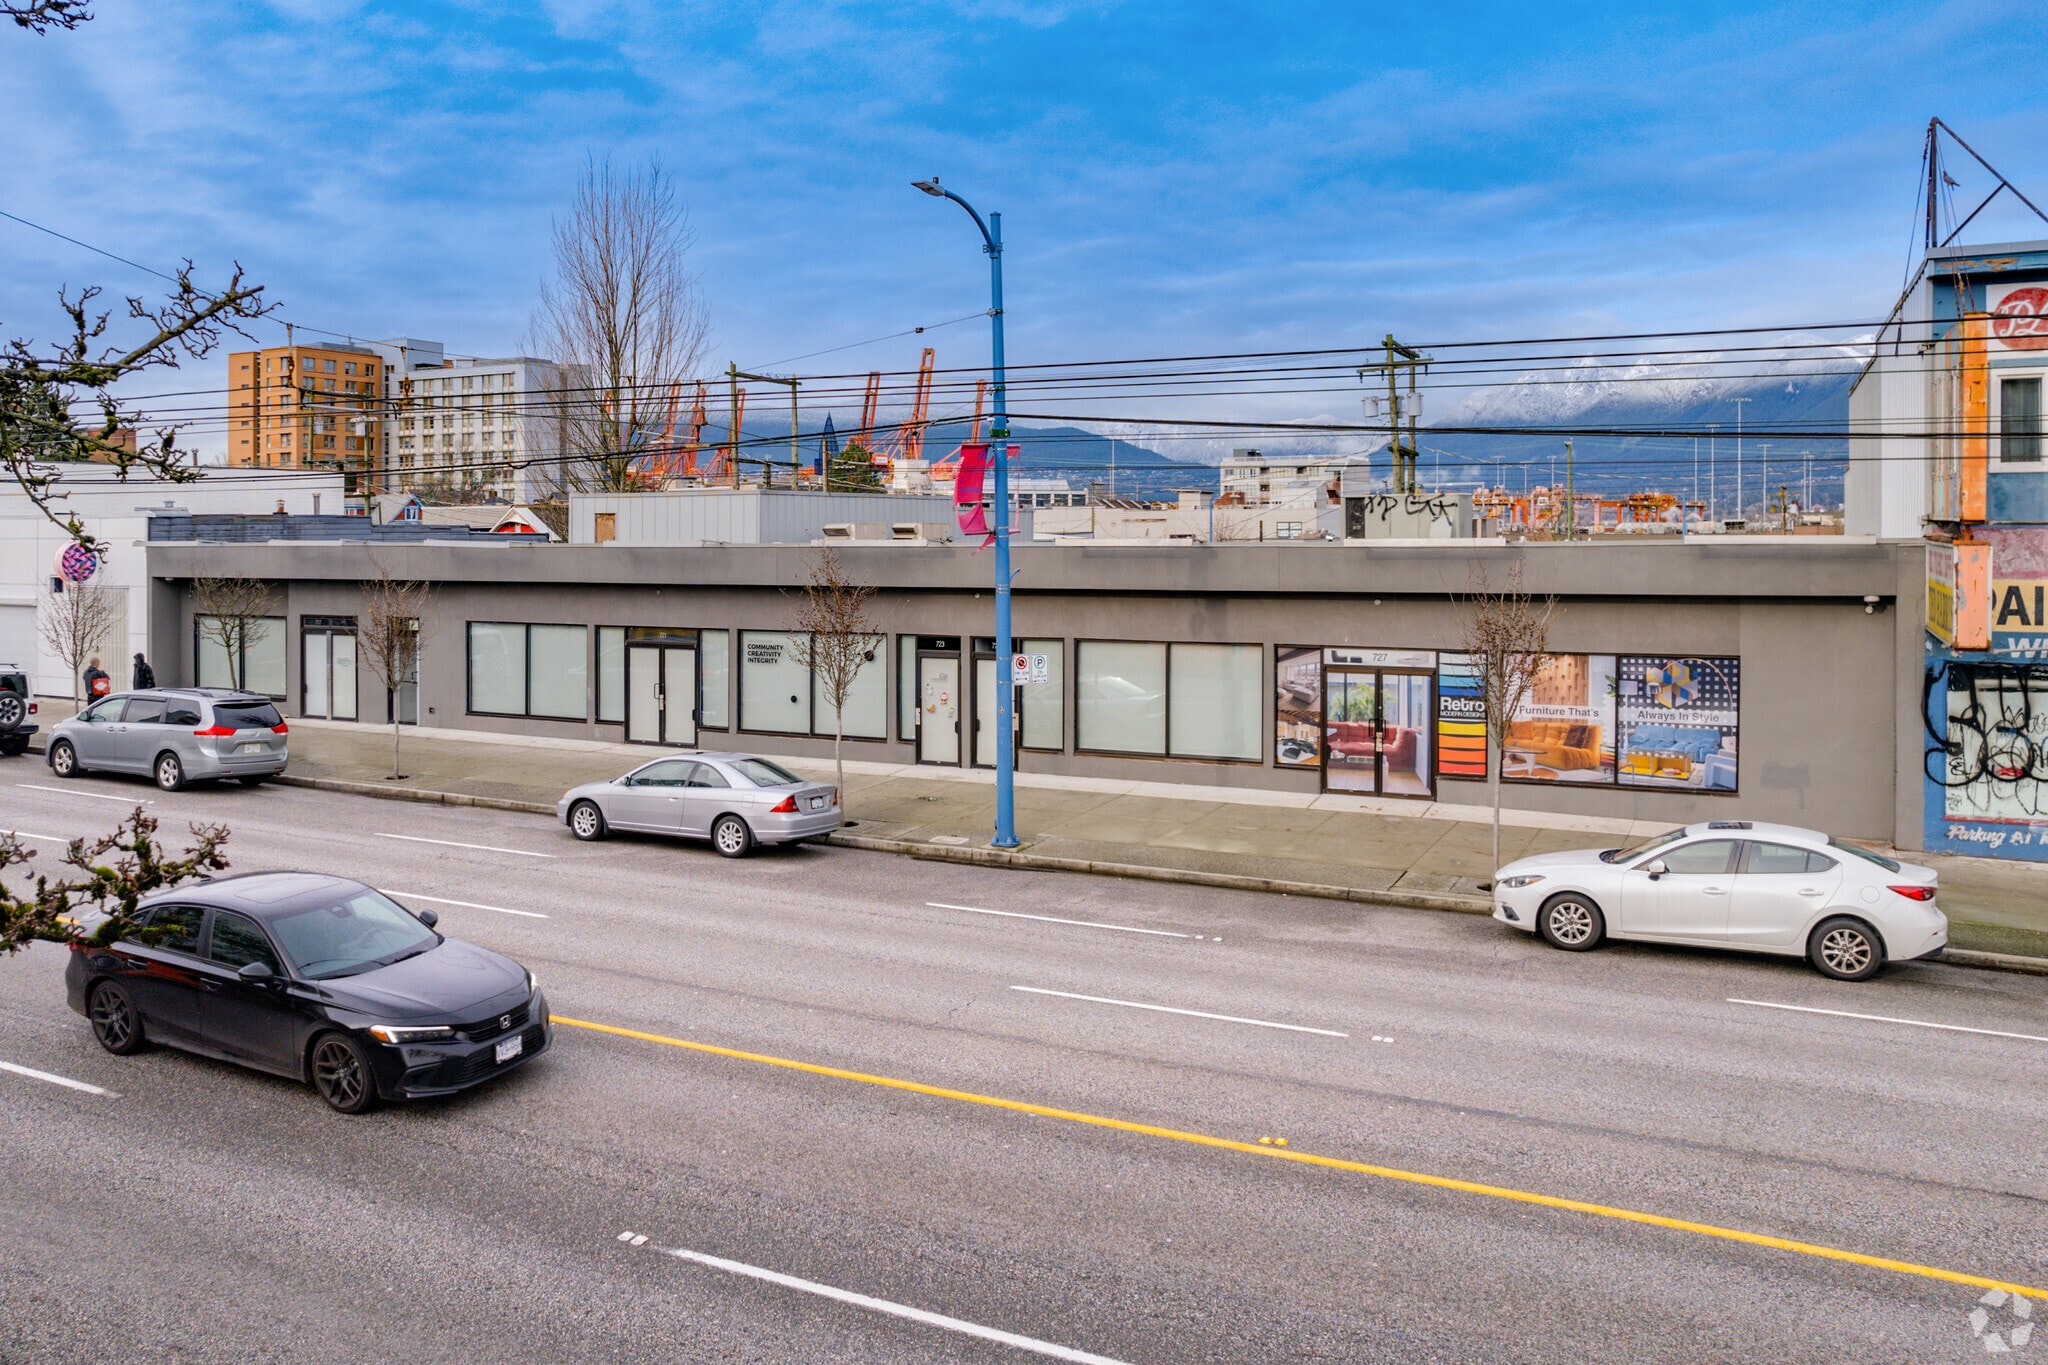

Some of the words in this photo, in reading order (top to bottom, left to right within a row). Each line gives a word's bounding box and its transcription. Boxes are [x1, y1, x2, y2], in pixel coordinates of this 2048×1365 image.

[1992, 586, 2045, 626] AI
[935, 640, 945, 648] 723
[1372, 653, 1388, 662] 727
[1440, 696, 1486, 712] Retro
[1519, 705, 1566, 716] Furniture
[1568, 707, 1600, 717] That's
[1637, 710, 1676, 722] Always
[1679, 712, 1689, 720] In
[1692, 712, 1720, 724] Style
[1947, 825, 2007, 849] Parking
